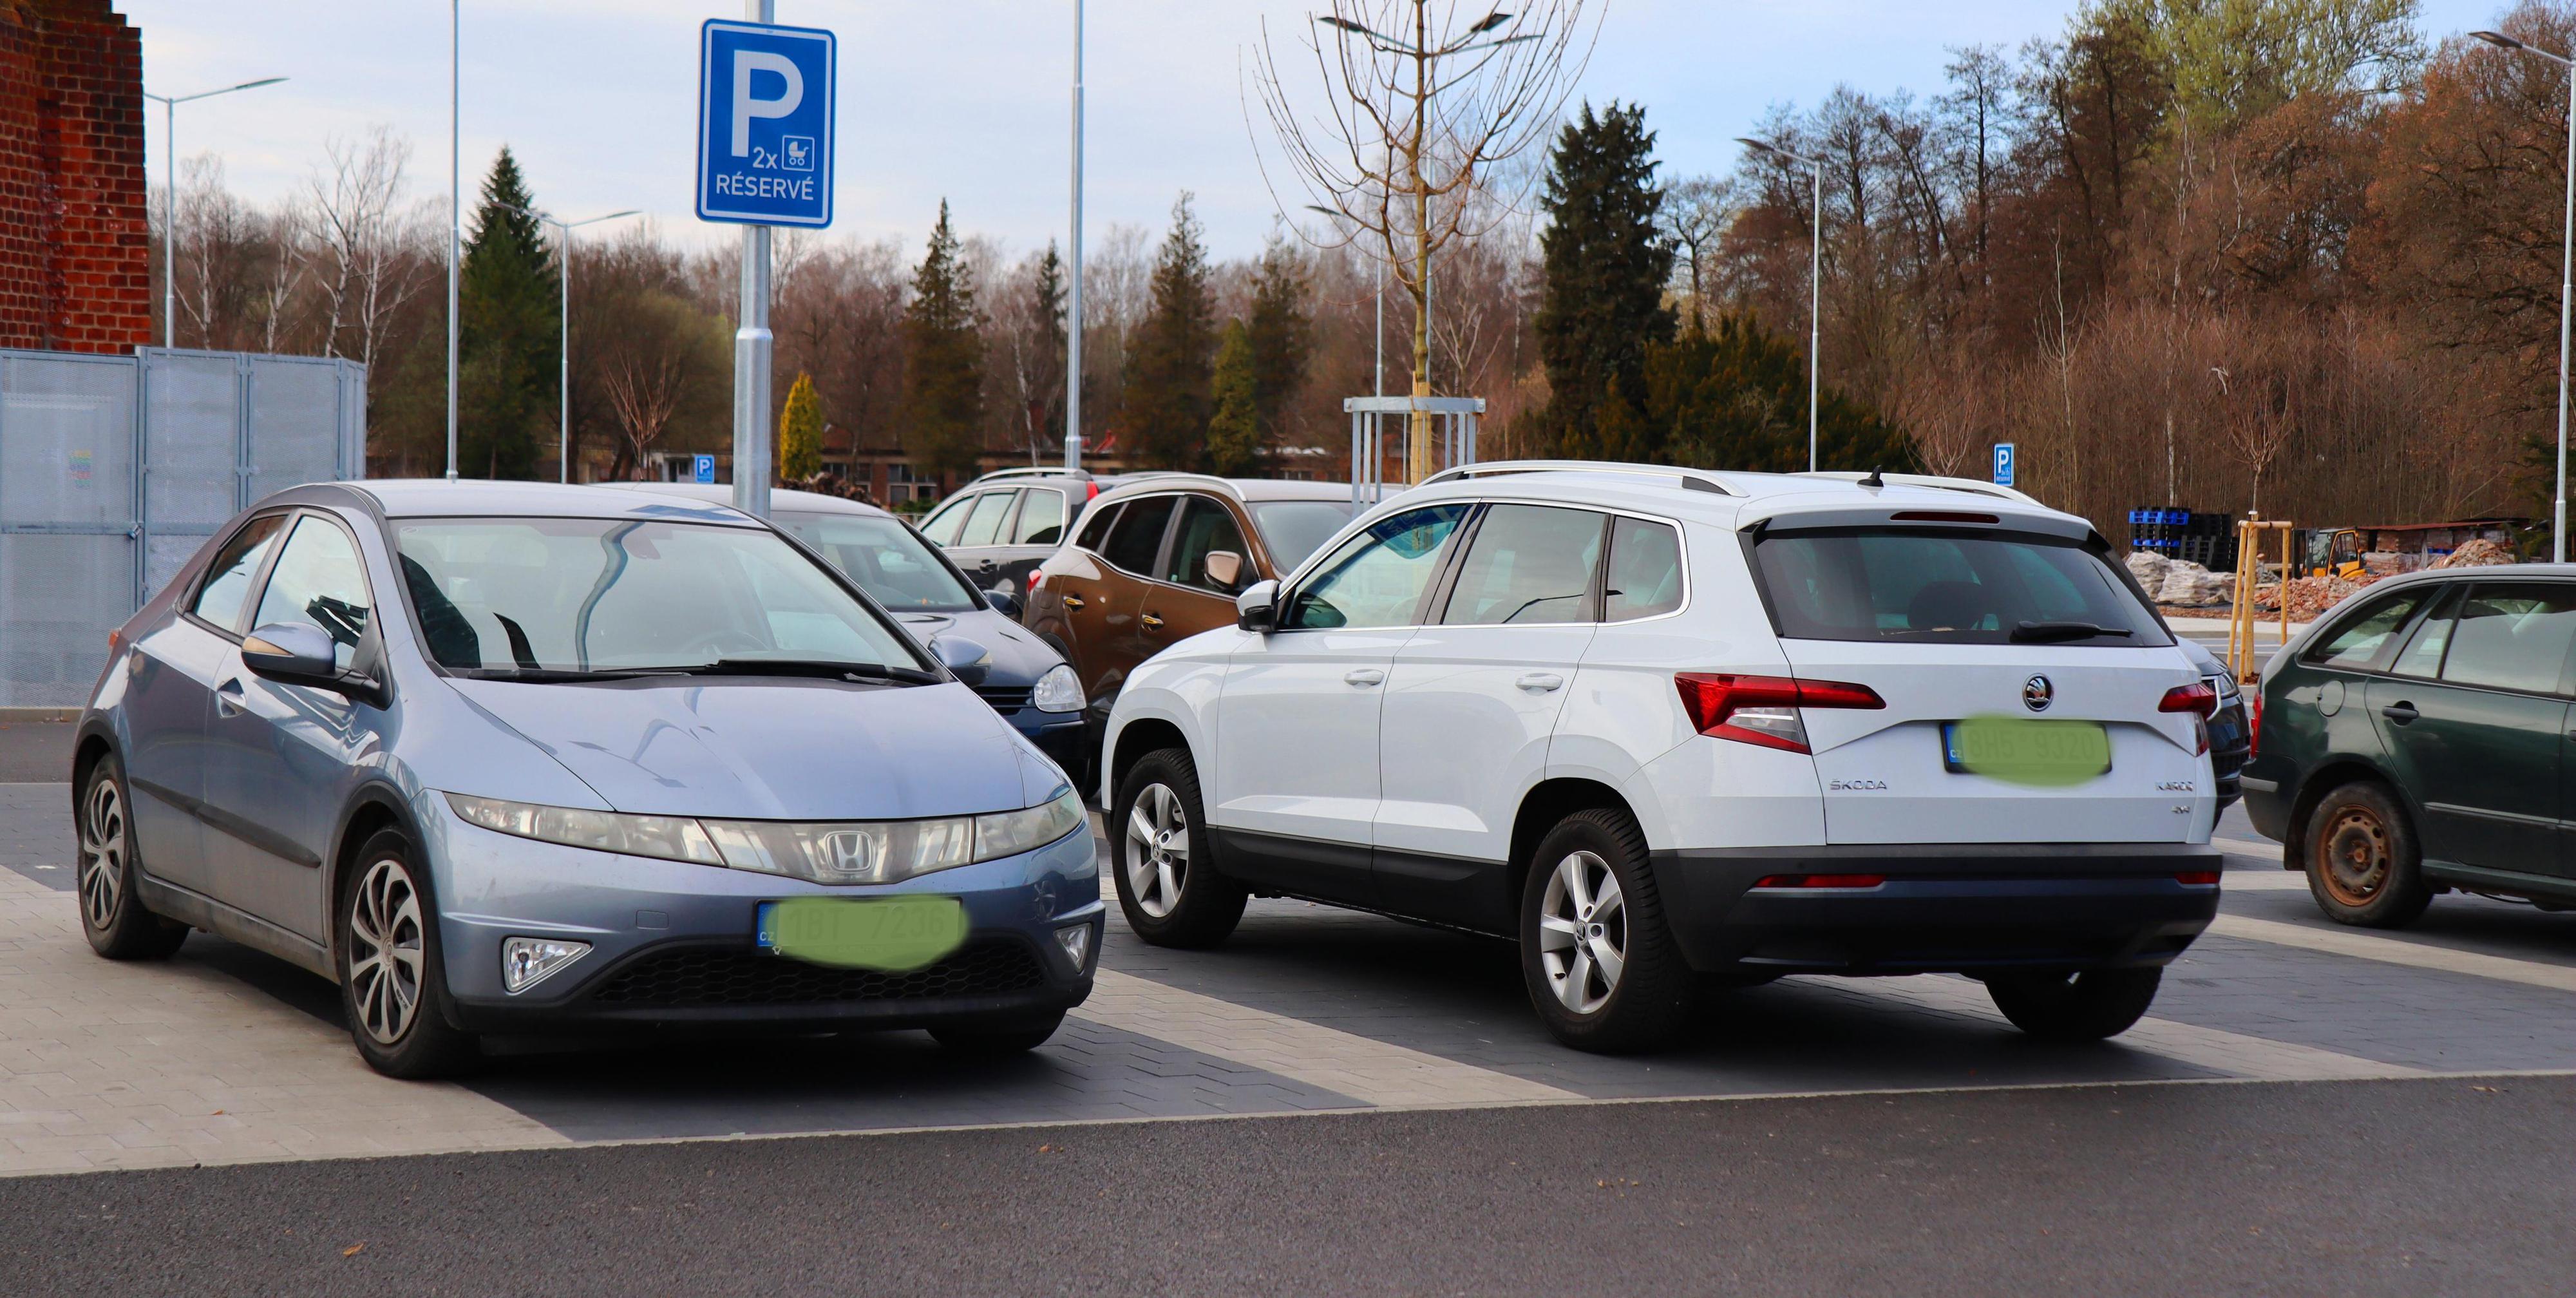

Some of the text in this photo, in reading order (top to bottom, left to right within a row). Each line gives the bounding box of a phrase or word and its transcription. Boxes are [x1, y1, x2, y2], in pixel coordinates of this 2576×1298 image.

[732, 50, 804, 157] P
[752, 146, 778, 169] 2x
[716, 171, 814, 200] RÉSERVÉ
[699, 459, 710, 474] P
[1998, 450, 2009, 473] P
[1830, 778, 1887, 790] ŠKODA
